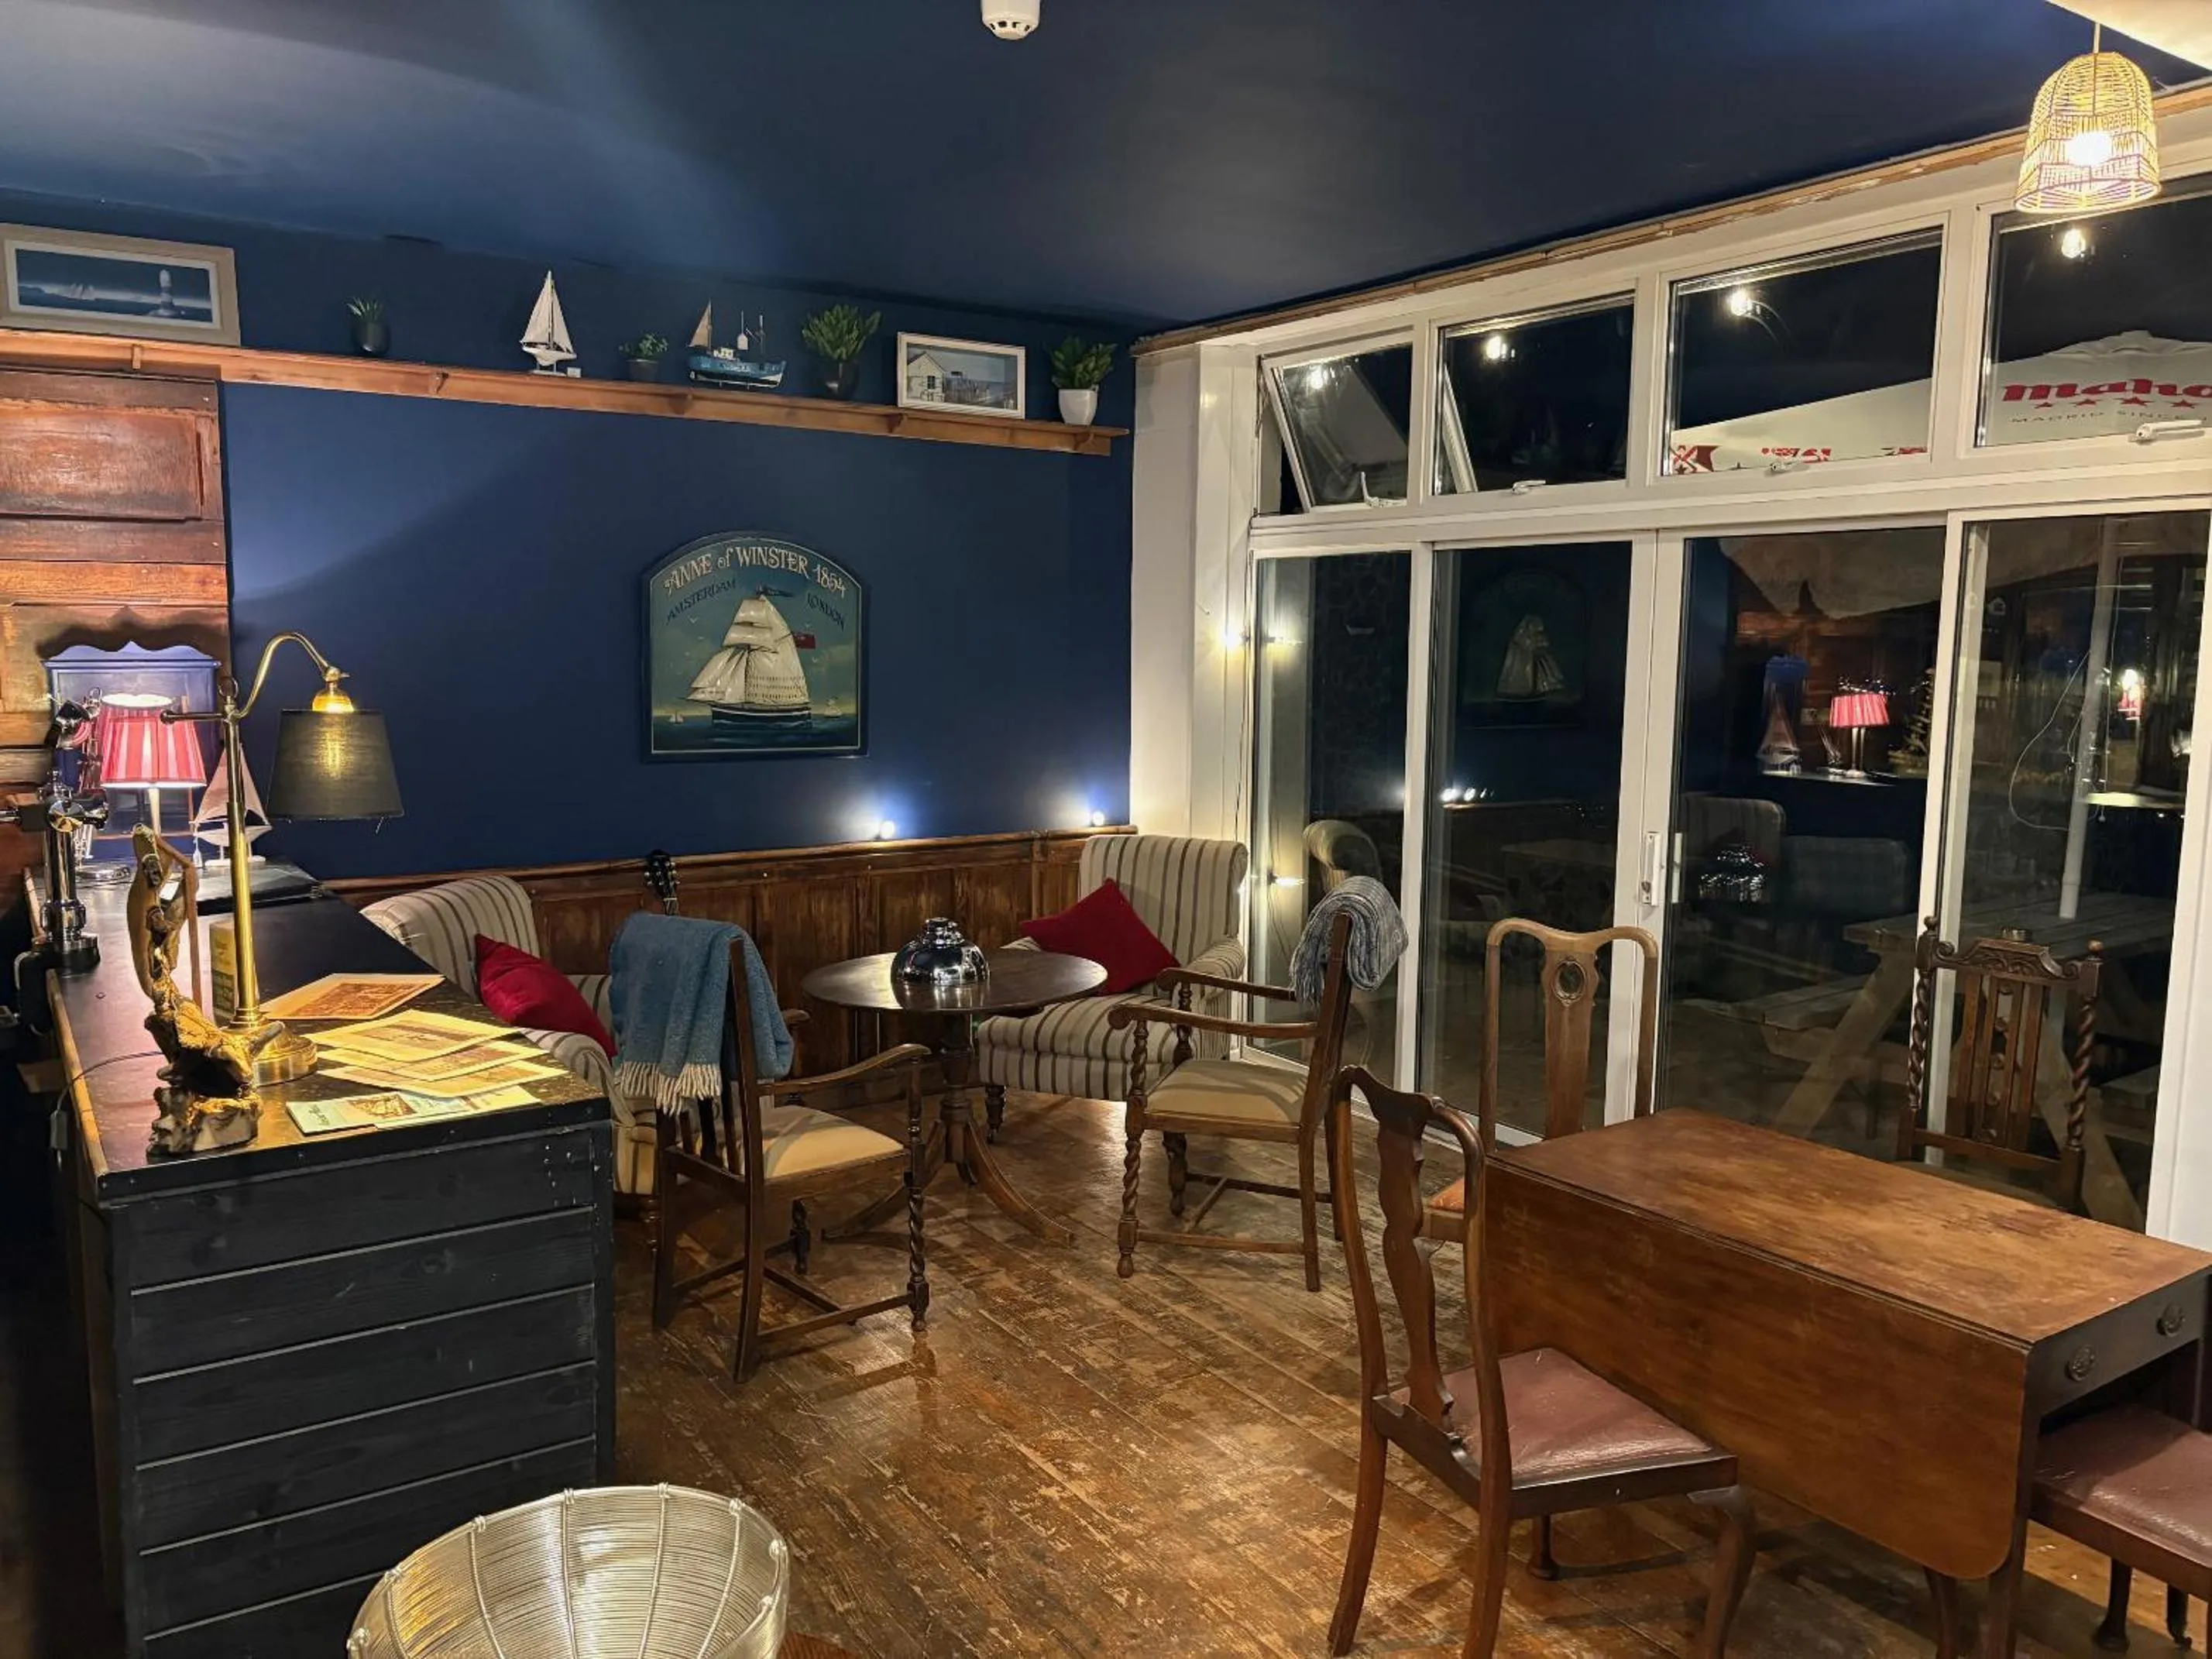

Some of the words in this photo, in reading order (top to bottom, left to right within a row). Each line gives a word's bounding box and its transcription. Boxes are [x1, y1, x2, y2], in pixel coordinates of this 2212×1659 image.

[2012, 410, 2105, 423] MADRID
[664, 554, 713, 596] ANNE
[717, 548, 734, 569] of
[734, 546, 810, 579] WINSTER
[812, 565, 847, 599] 1854
[666, 579, 737, 625] AMSTERDAM
[807, 592, 844, 631] LONDON
